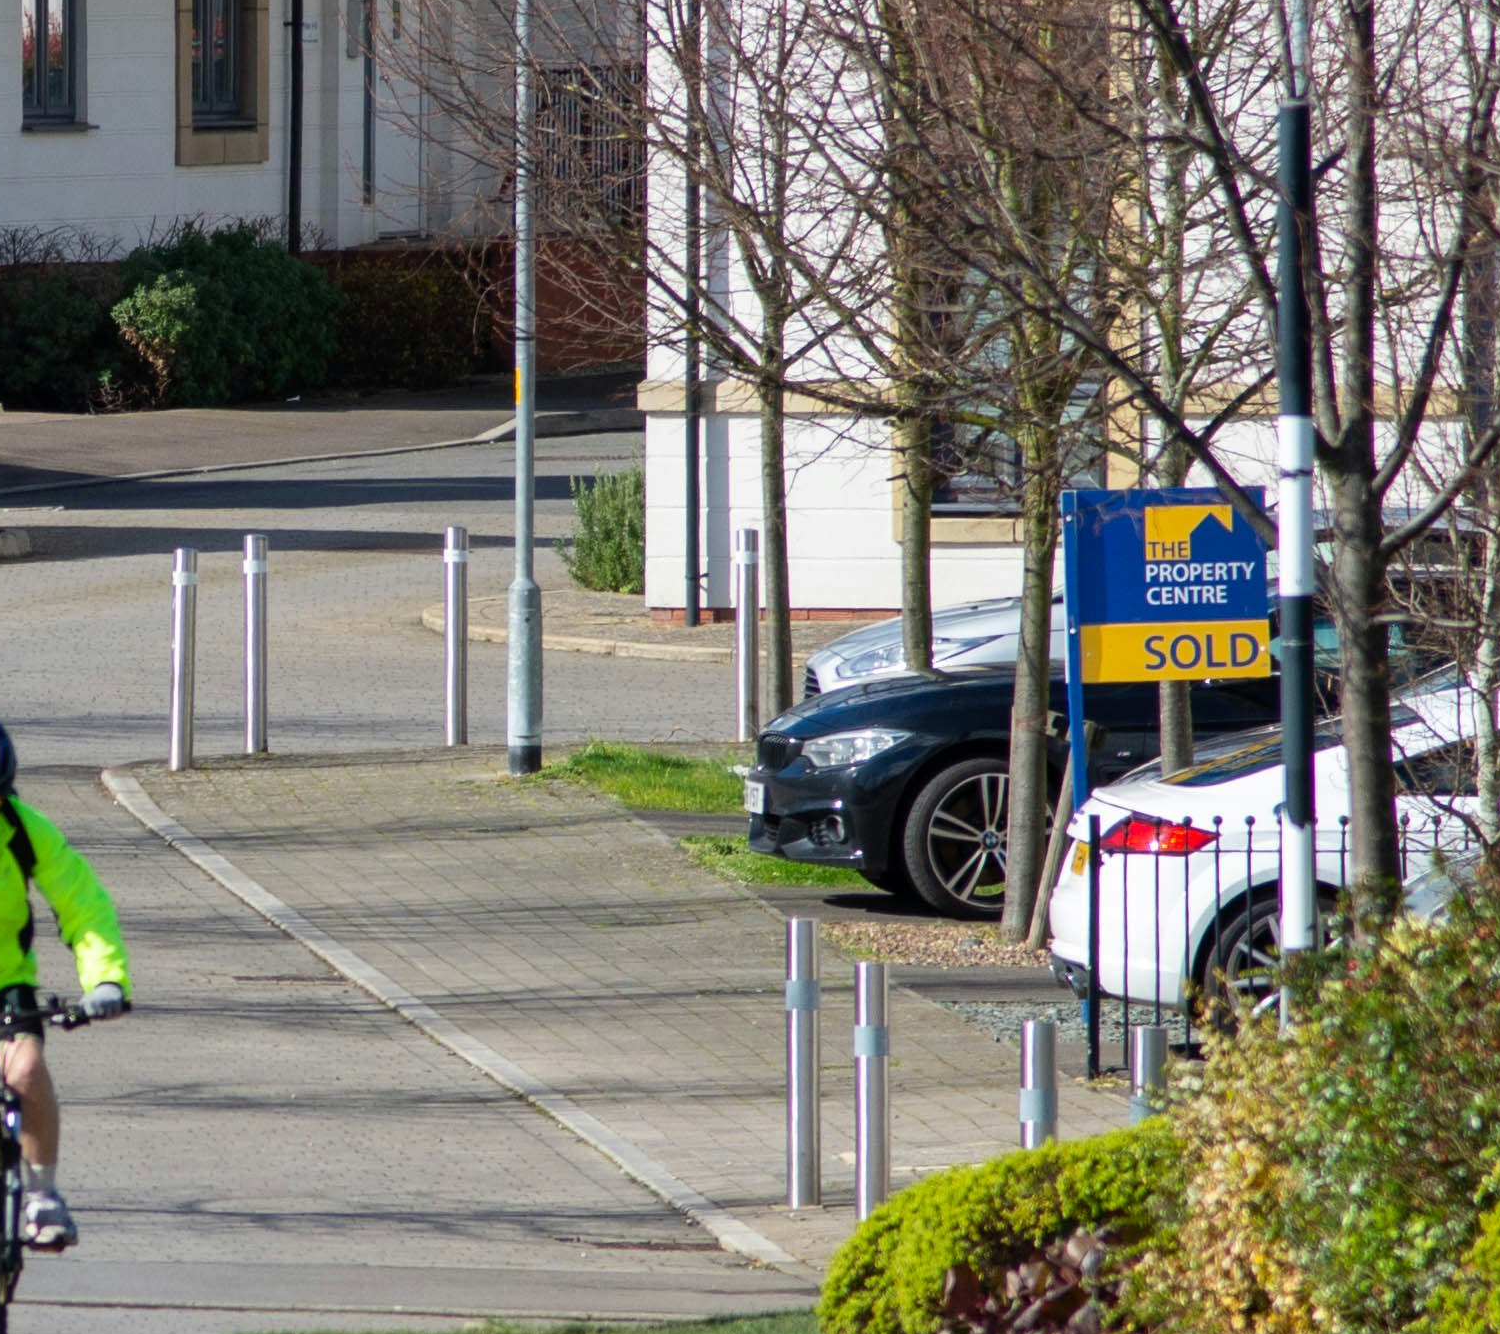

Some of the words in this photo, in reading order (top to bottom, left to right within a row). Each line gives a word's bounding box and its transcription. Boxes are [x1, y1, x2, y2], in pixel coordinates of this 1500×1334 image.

[1147, 540, 1189, 559] THE
[1145, 561, 1256, 583] PROPERTY
[1146, 585, 1228, 606] CENTRE
[1143, 632, 1260, 671] SOLD
